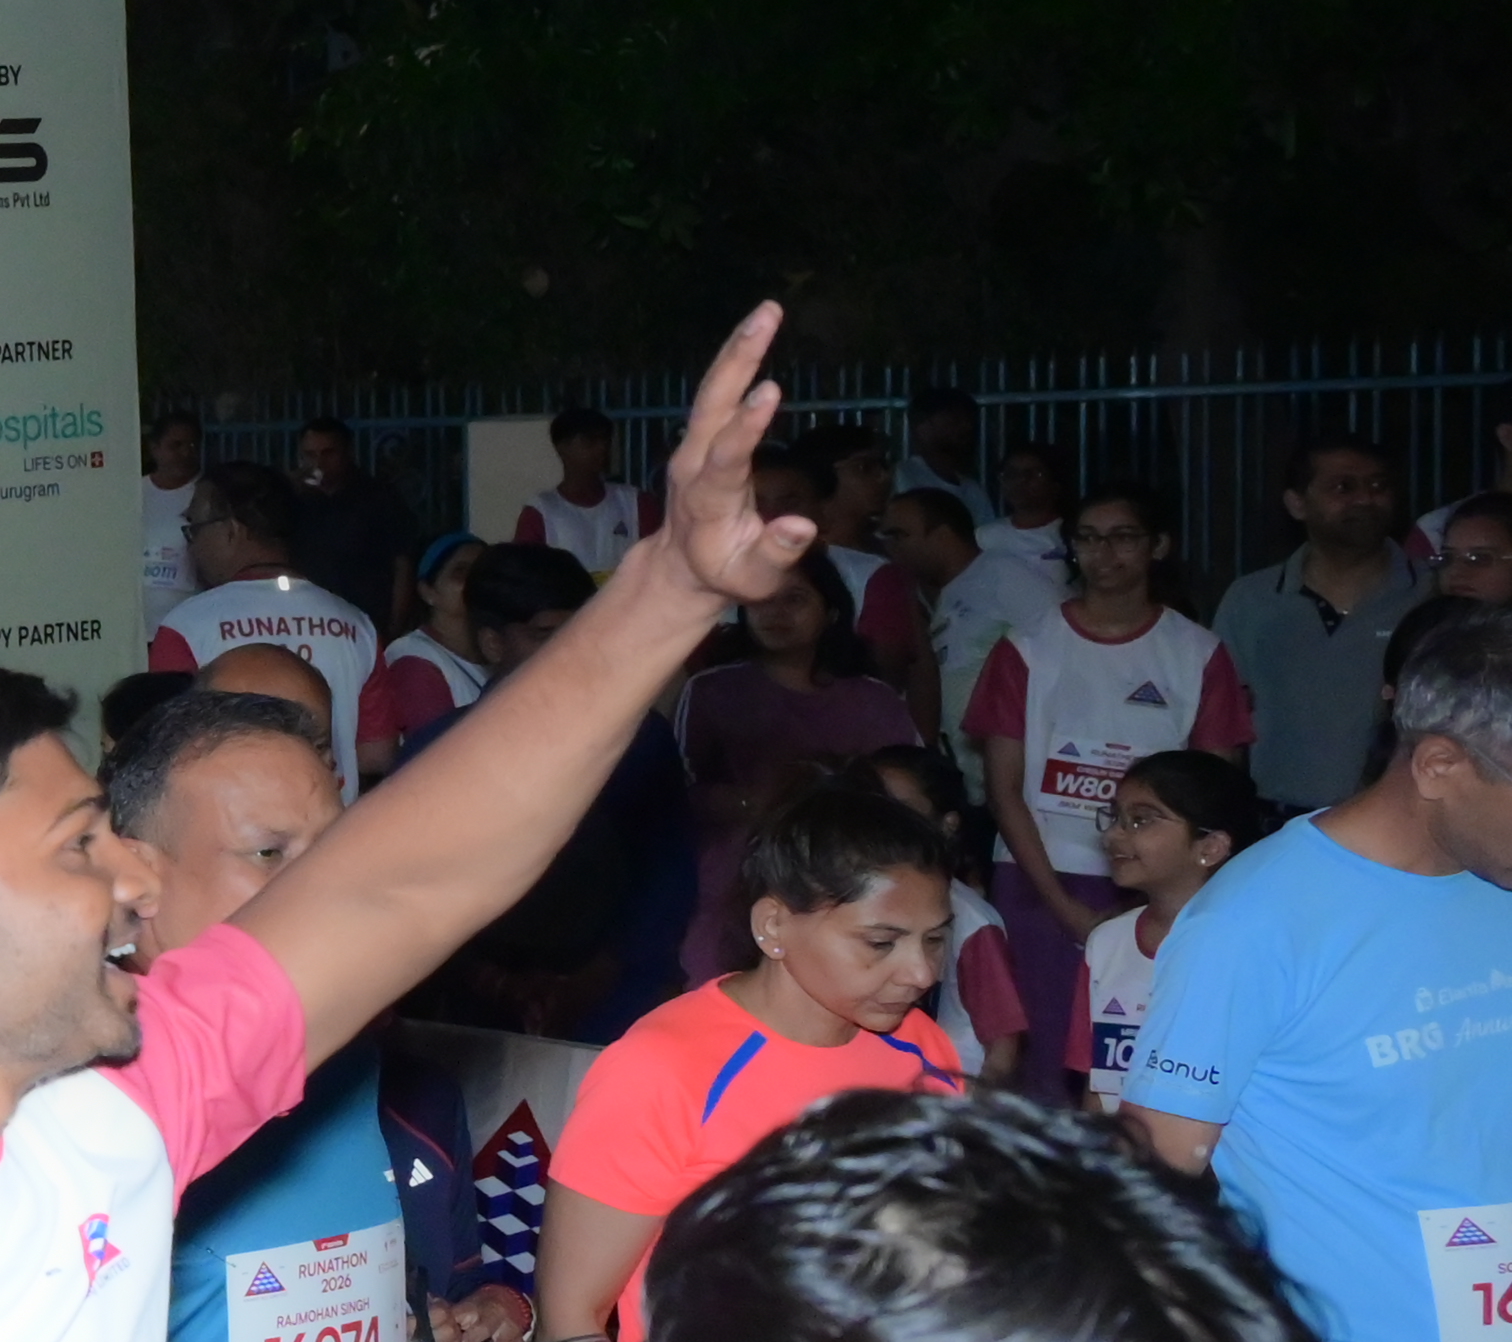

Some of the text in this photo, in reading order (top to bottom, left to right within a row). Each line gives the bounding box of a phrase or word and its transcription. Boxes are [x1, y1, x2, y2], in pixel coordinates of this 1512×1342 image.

[13, 193, 30, 208] Pvt
[33, 191, 51, 207] Ltd
[23, 453, 88, 472] LIFE'S ON
[17, 619, 102, 654] PARTNER
[218, 616, 357, 644] RUNATHON
[298, 1250, 368, 1279] RUNATHON
[321, 1275, 352, 1294] 2026
[276, 1297, 370, 1329] RAJMOHAN SINGH
